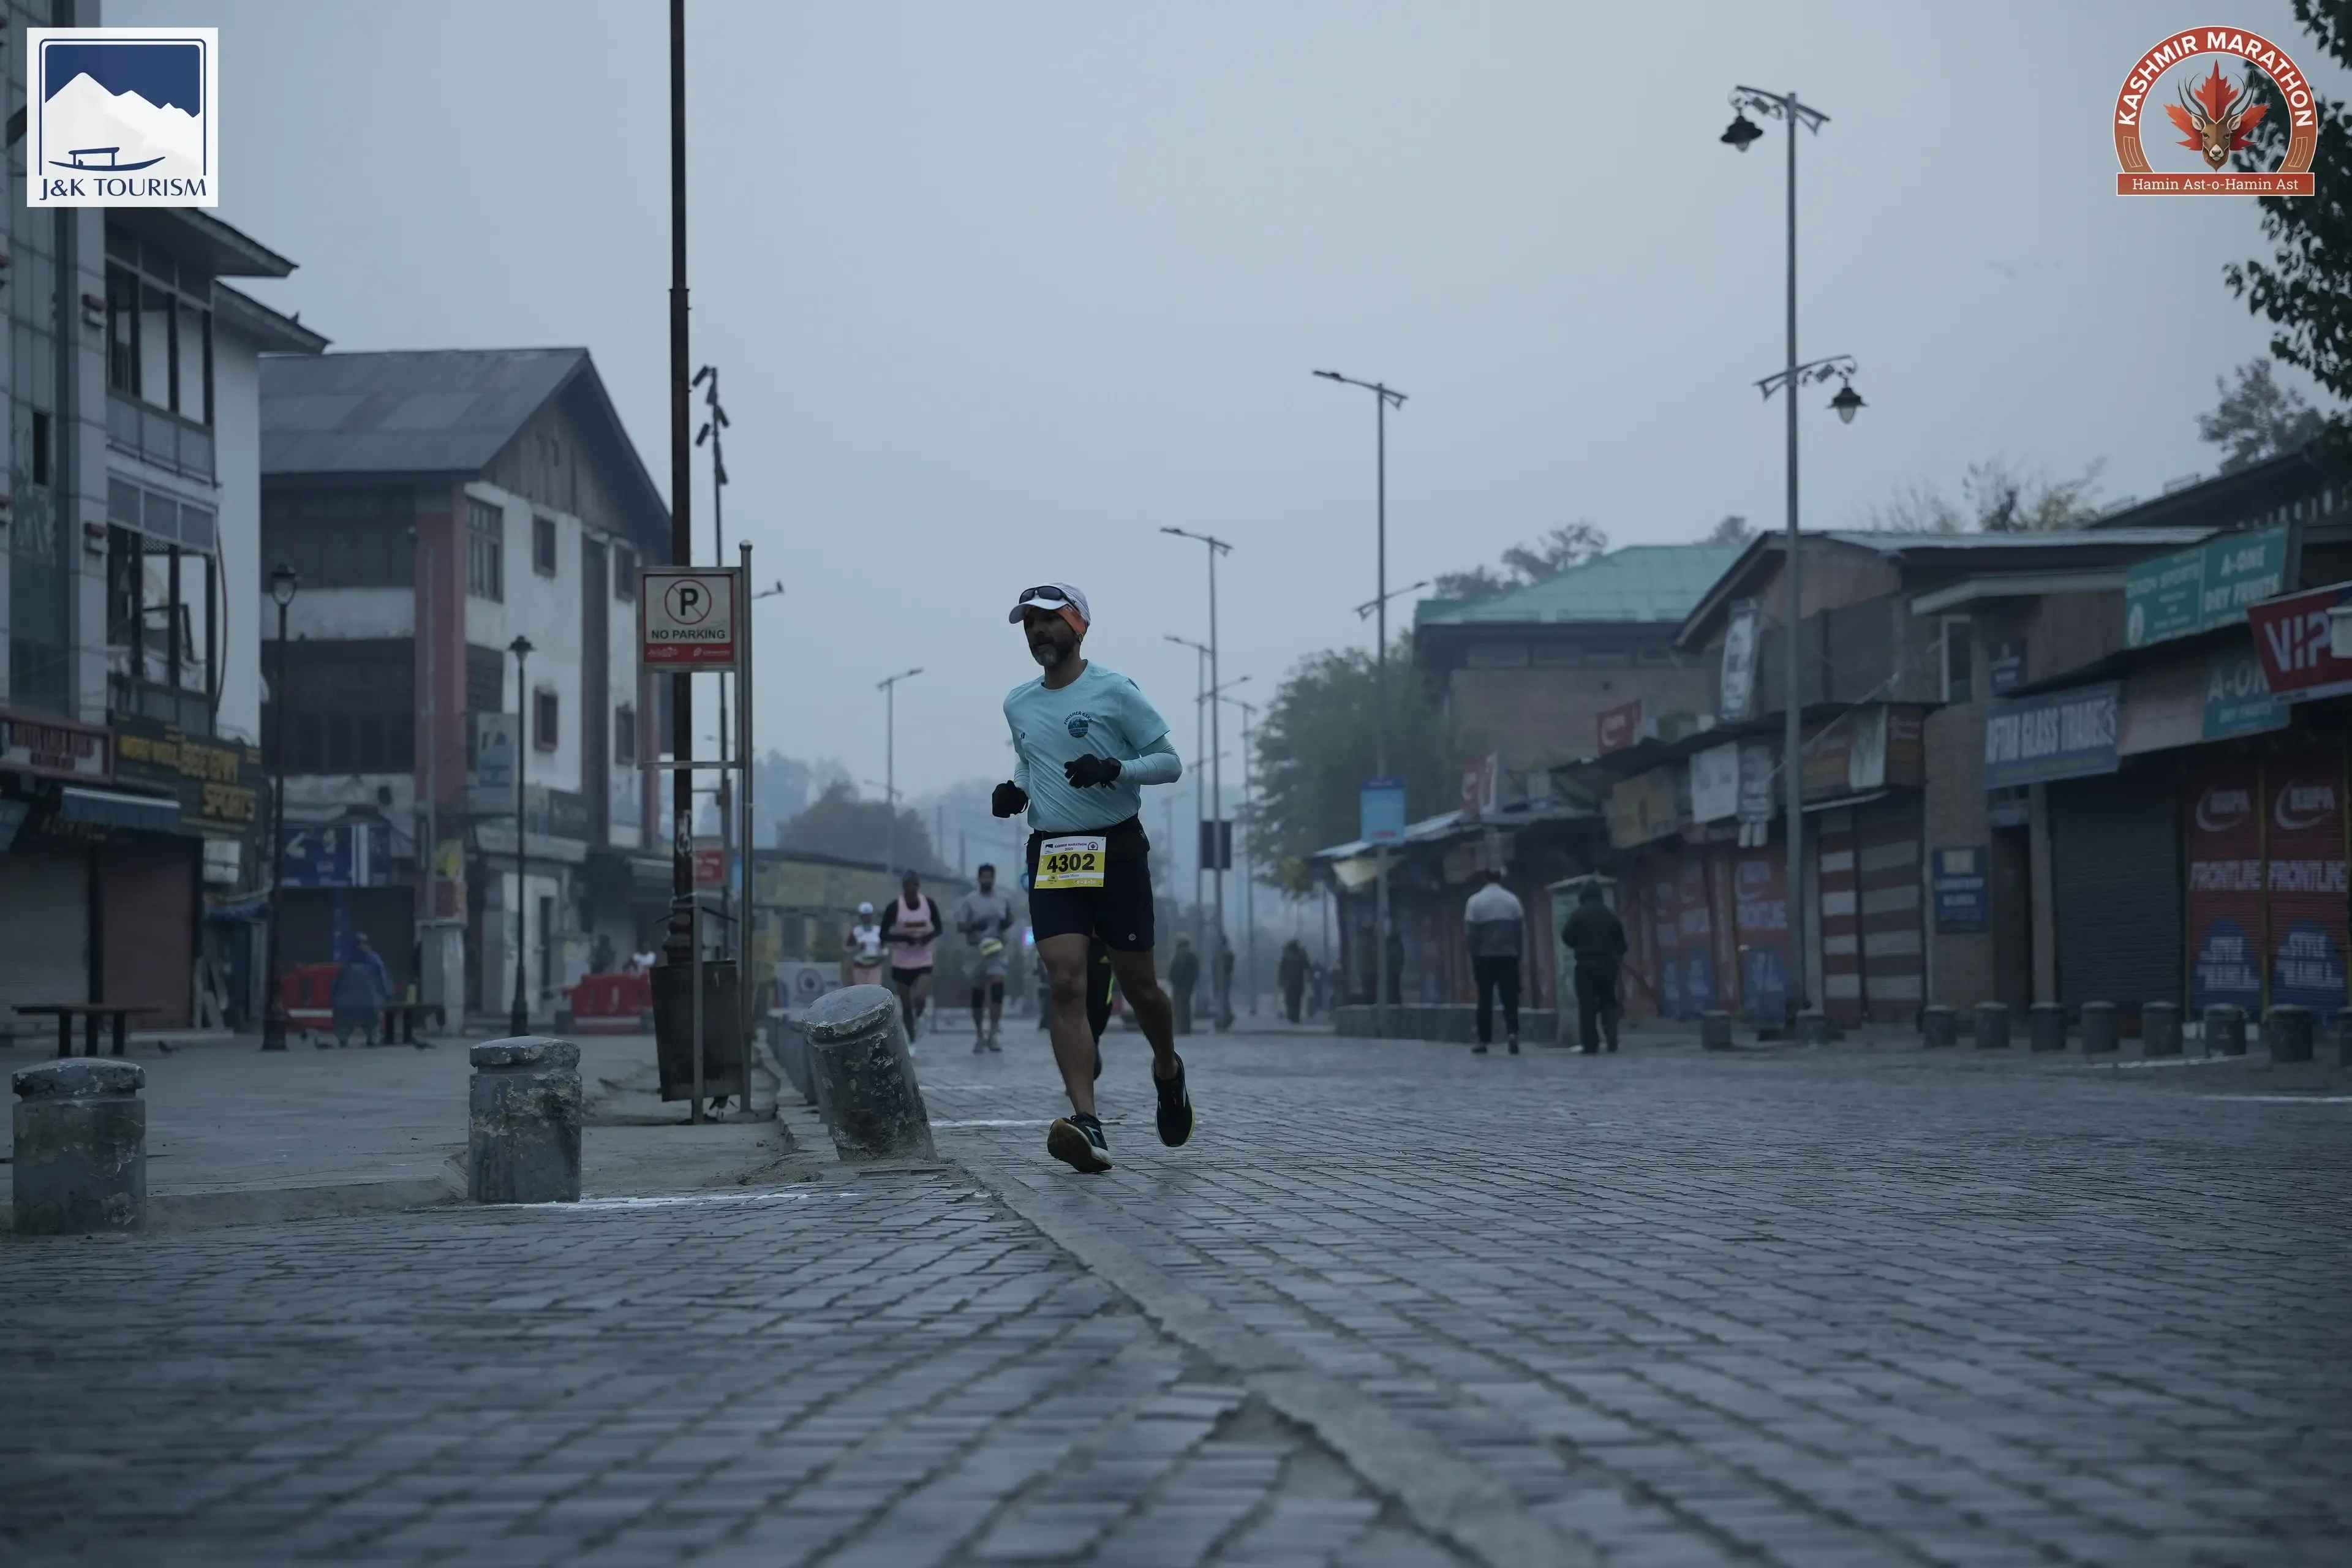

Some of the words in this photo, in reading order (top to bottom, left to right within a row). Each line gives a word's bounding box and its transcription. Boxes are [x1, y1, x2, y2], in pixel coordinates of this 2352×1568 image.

[651, 630, 669, 639] NO
[673, 629, 725, 639] PARKING
[2264, 611, 2331, 672] VIP
[2207, 657, 2270, 702] A-ON
[1064, 711, 1082, 725] FINISHER
[1047, 853, 1095, 873] 4302
